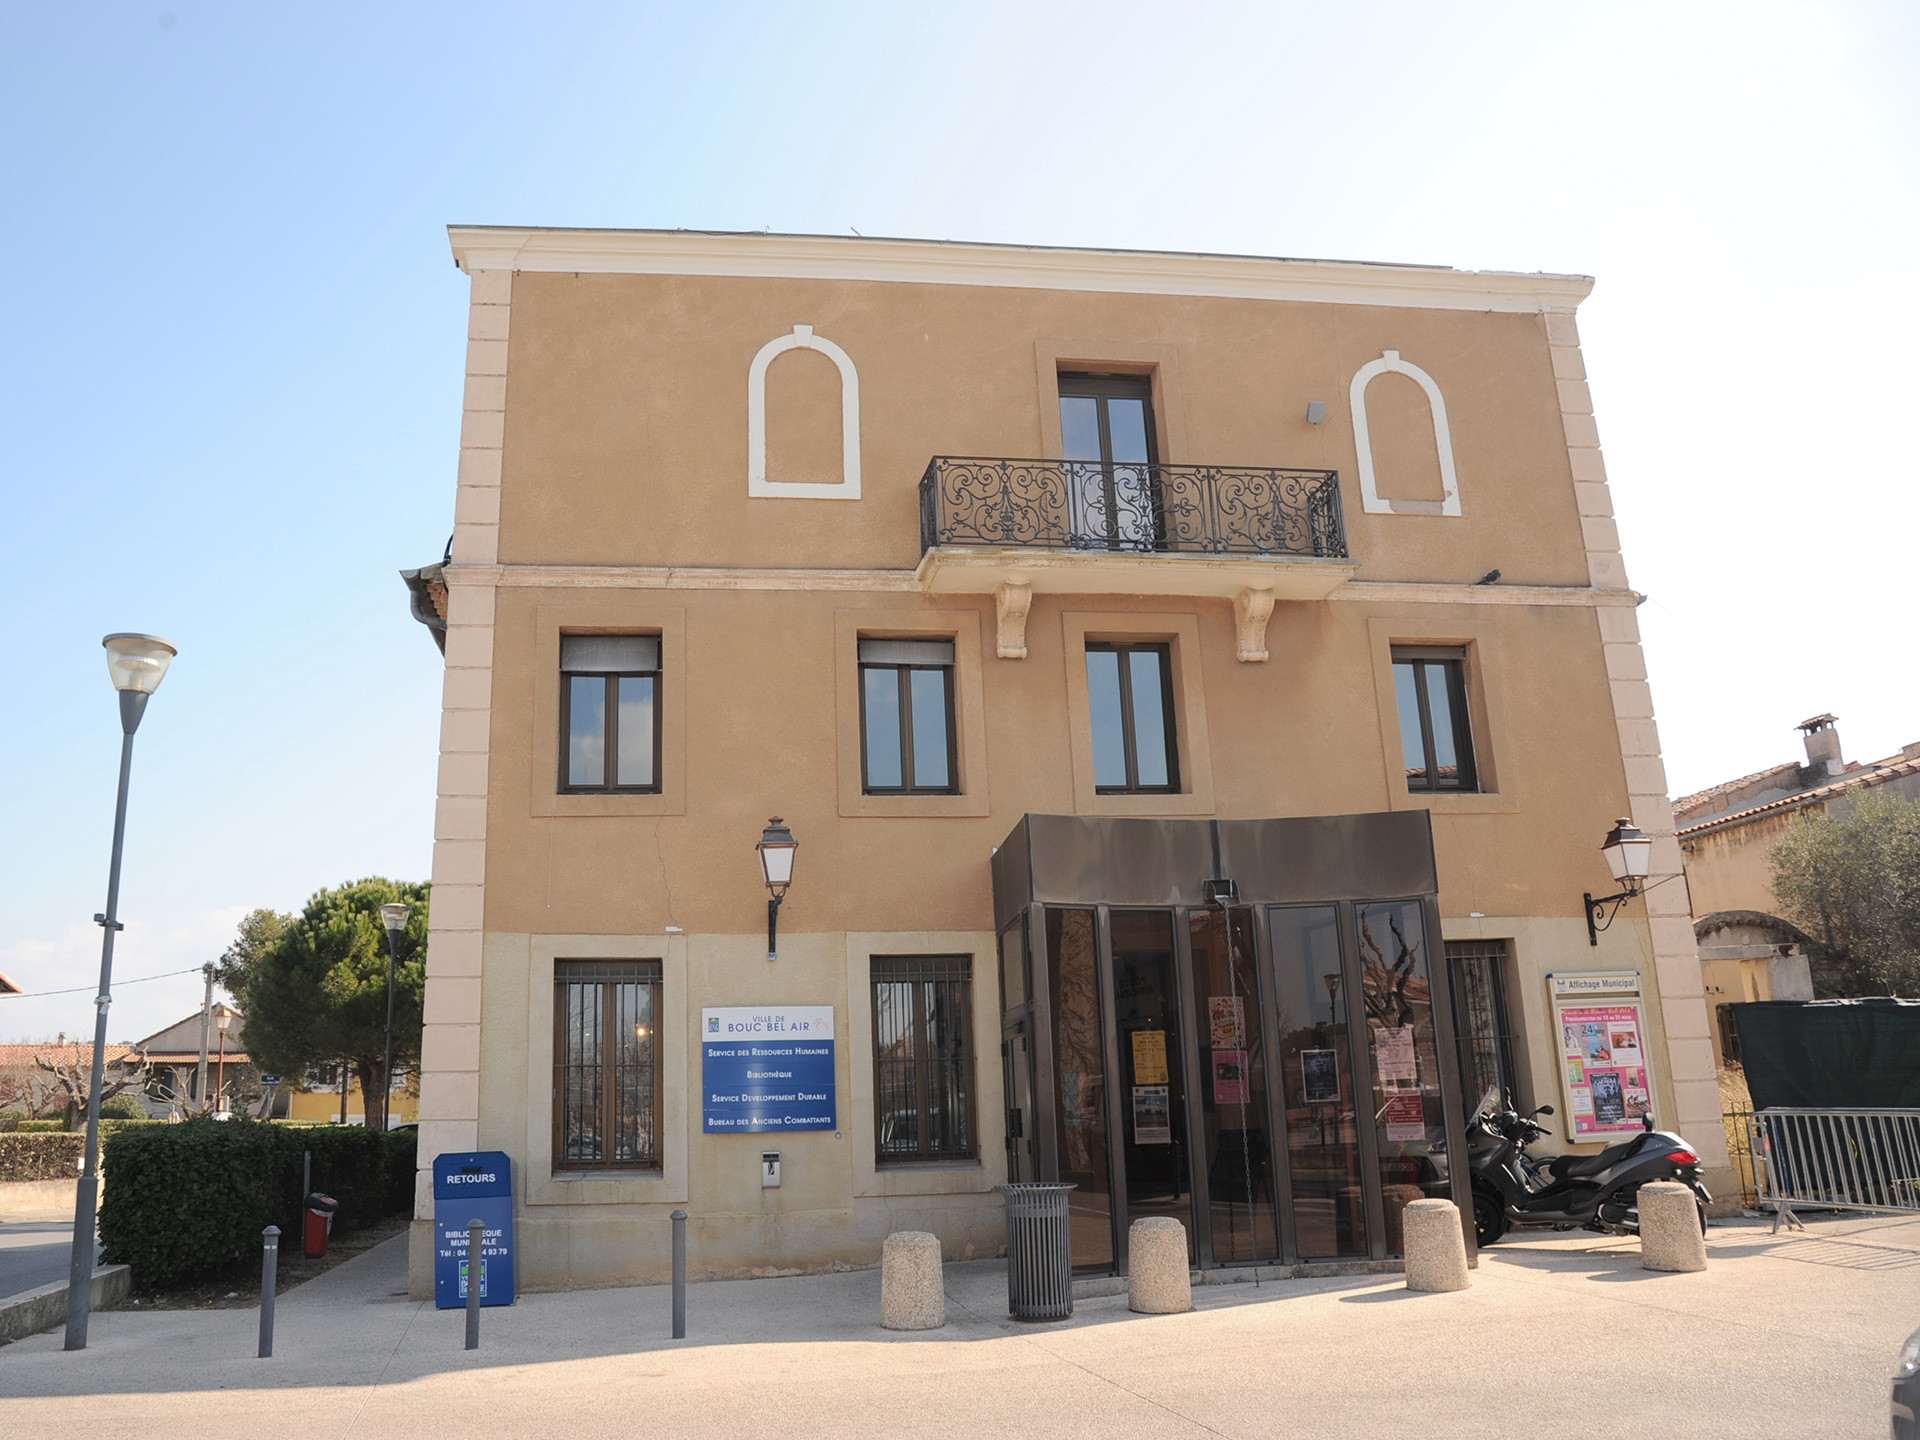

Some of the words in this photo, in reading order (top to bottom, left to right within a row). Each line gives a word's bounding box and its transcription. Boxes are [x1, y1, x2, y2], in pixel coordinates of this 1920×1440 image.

[1568, 980, 1600, 990] Affichage
[1602, 979, 1635, 989] Municipal
[728, 1023, 762, 1032] BOUC
[767, 1022, 786, 1032] BEL
[790, 1022, 810, 1031] AIR
[446, 1174, 496, 1184] RETOURS
